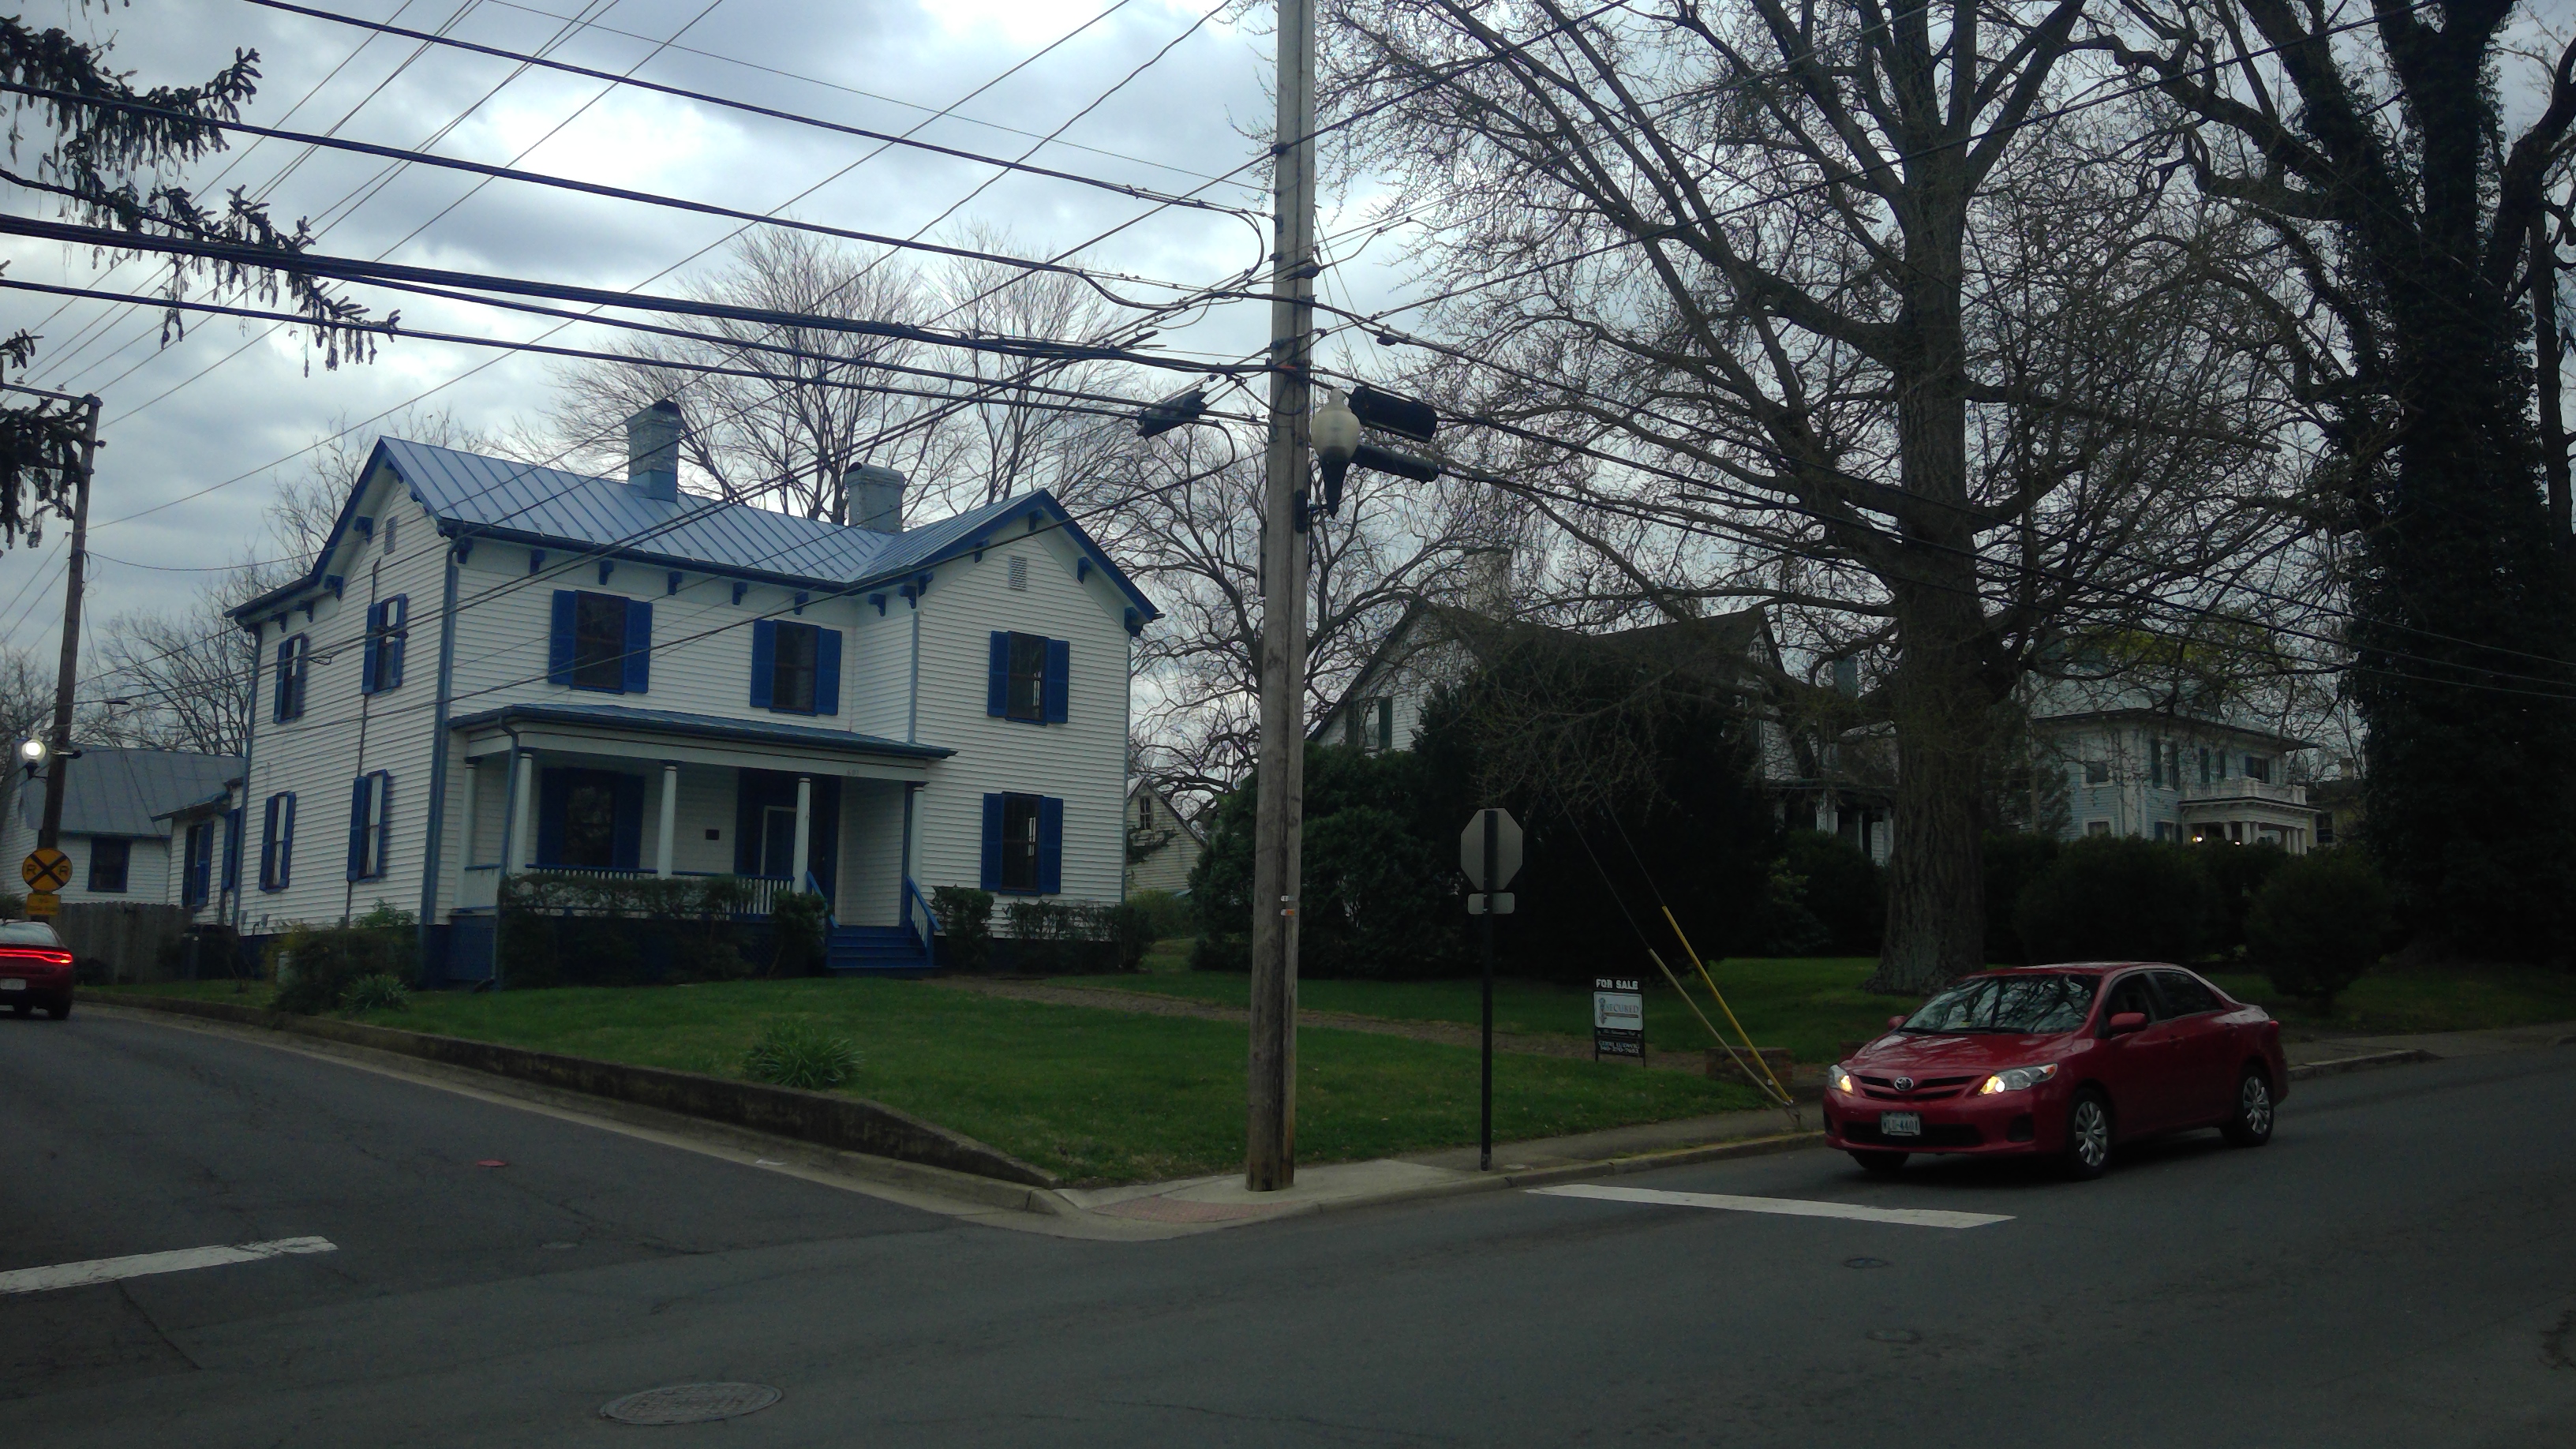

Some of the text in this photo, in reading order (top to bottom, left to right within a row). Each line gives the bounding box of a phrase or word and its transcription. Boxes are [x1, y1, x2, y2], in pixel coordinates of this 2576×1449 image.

[26, 863, 69, 876] R R
[1596, 978, 1638, 990] FOR SALE
[1605, 1004, 1639, 1013] SECURED
